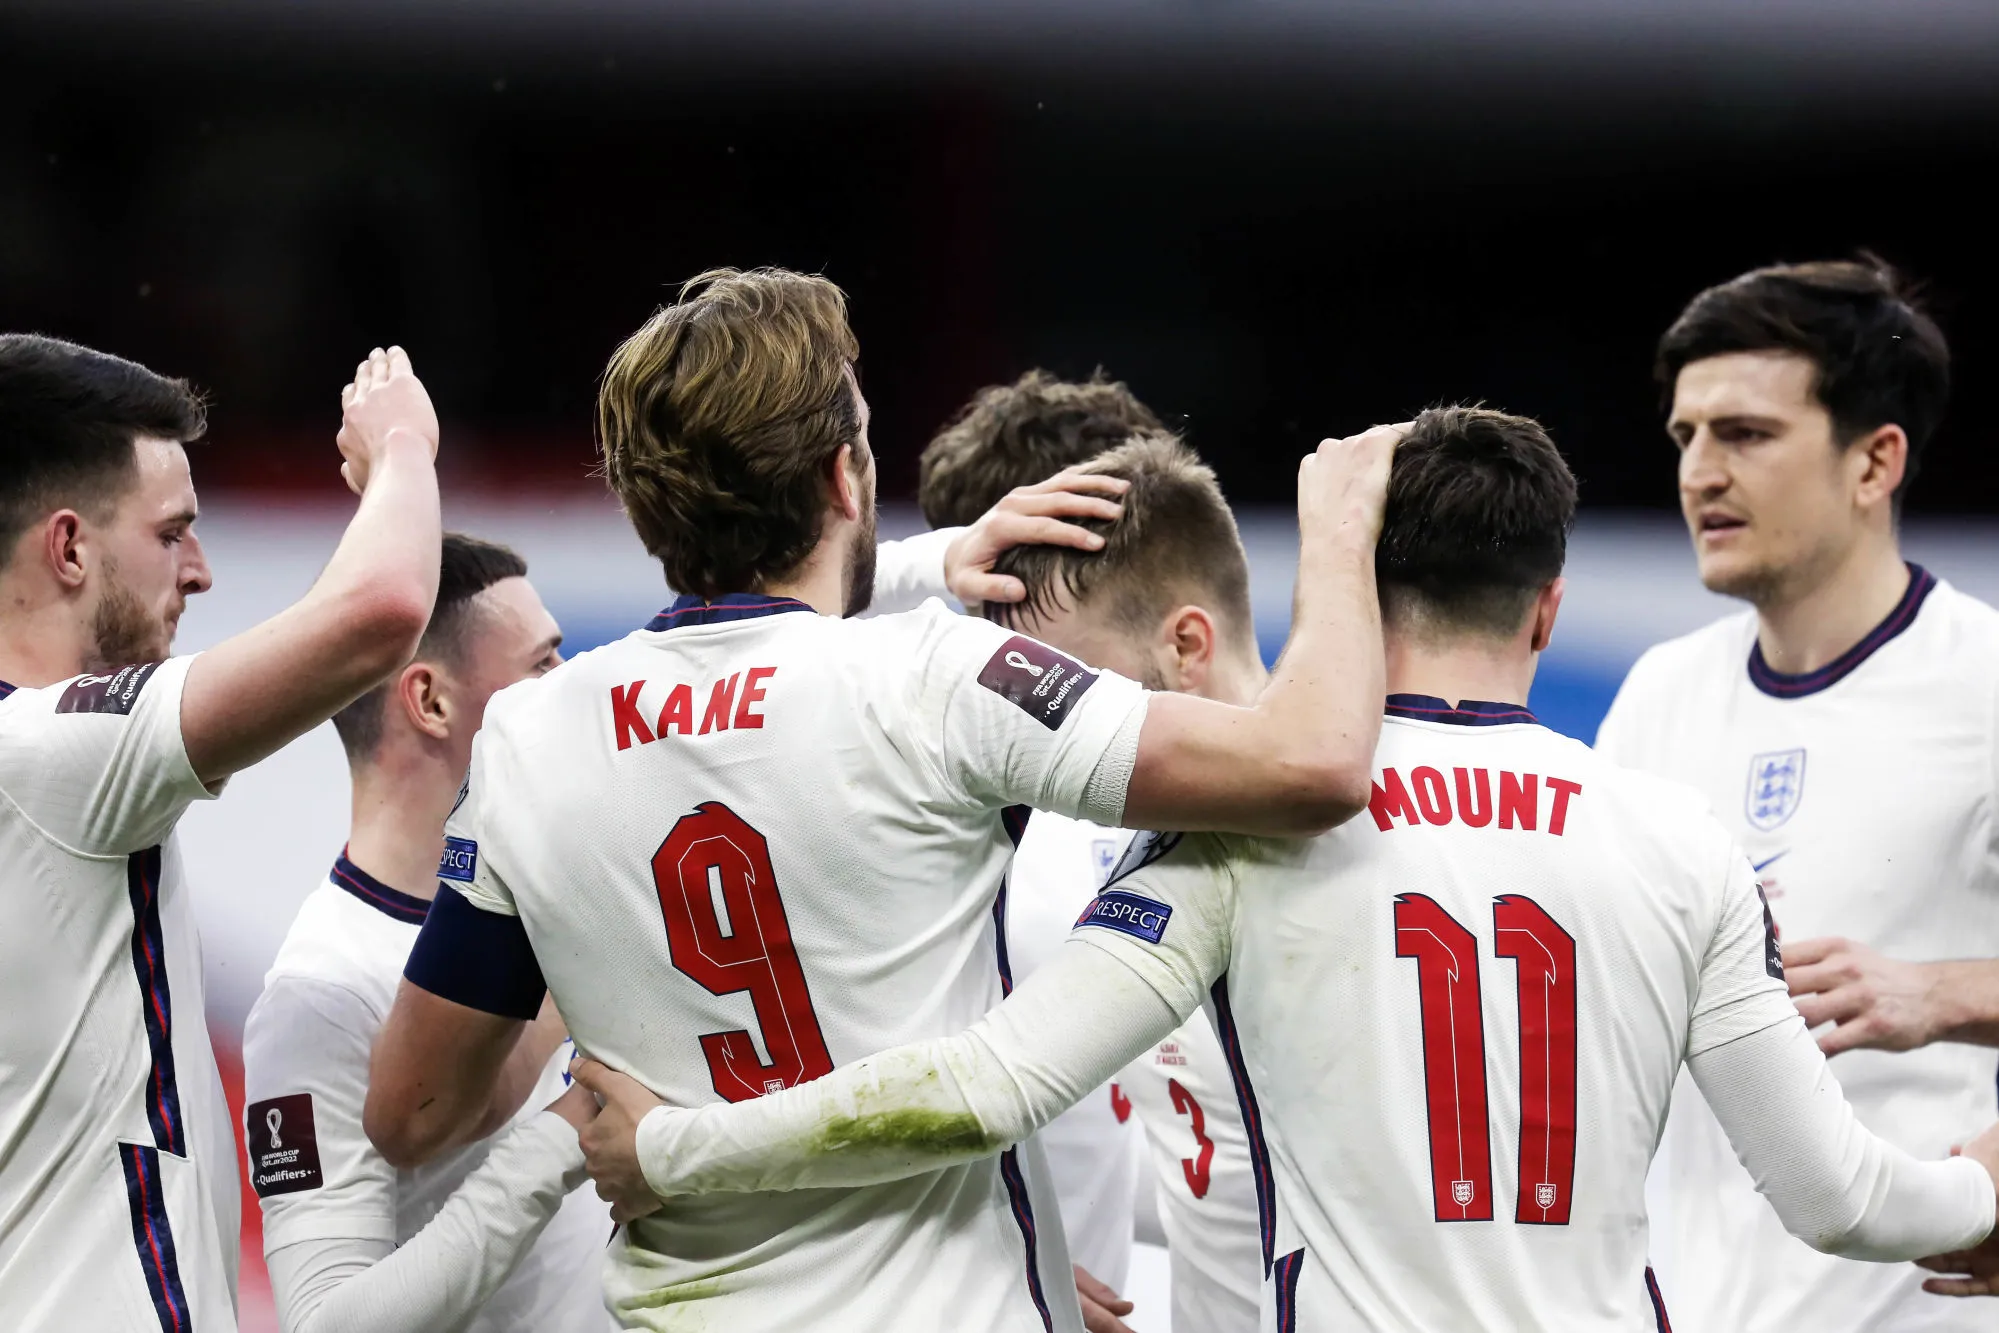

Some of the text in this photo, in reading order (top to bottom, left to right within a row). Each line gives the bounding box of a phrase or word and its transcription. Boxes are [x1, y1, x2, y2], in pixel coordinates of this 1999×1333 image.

[611, 667, 778, 751] KANE
[1048, 674, 1082, 711] Qualifiers
[1368, 766, 1582, 836] MOUNT
[440, 848, 475, 870] SPECT
[651, 800, 834, 1104] 9
[1093, 902, 1167, 932] RESPECT
[1393, 892, 1577, 1225] 11
[1168, 1078, 1215, 1200] 3
[260, 1170, 307, 1186] Qualifiers
